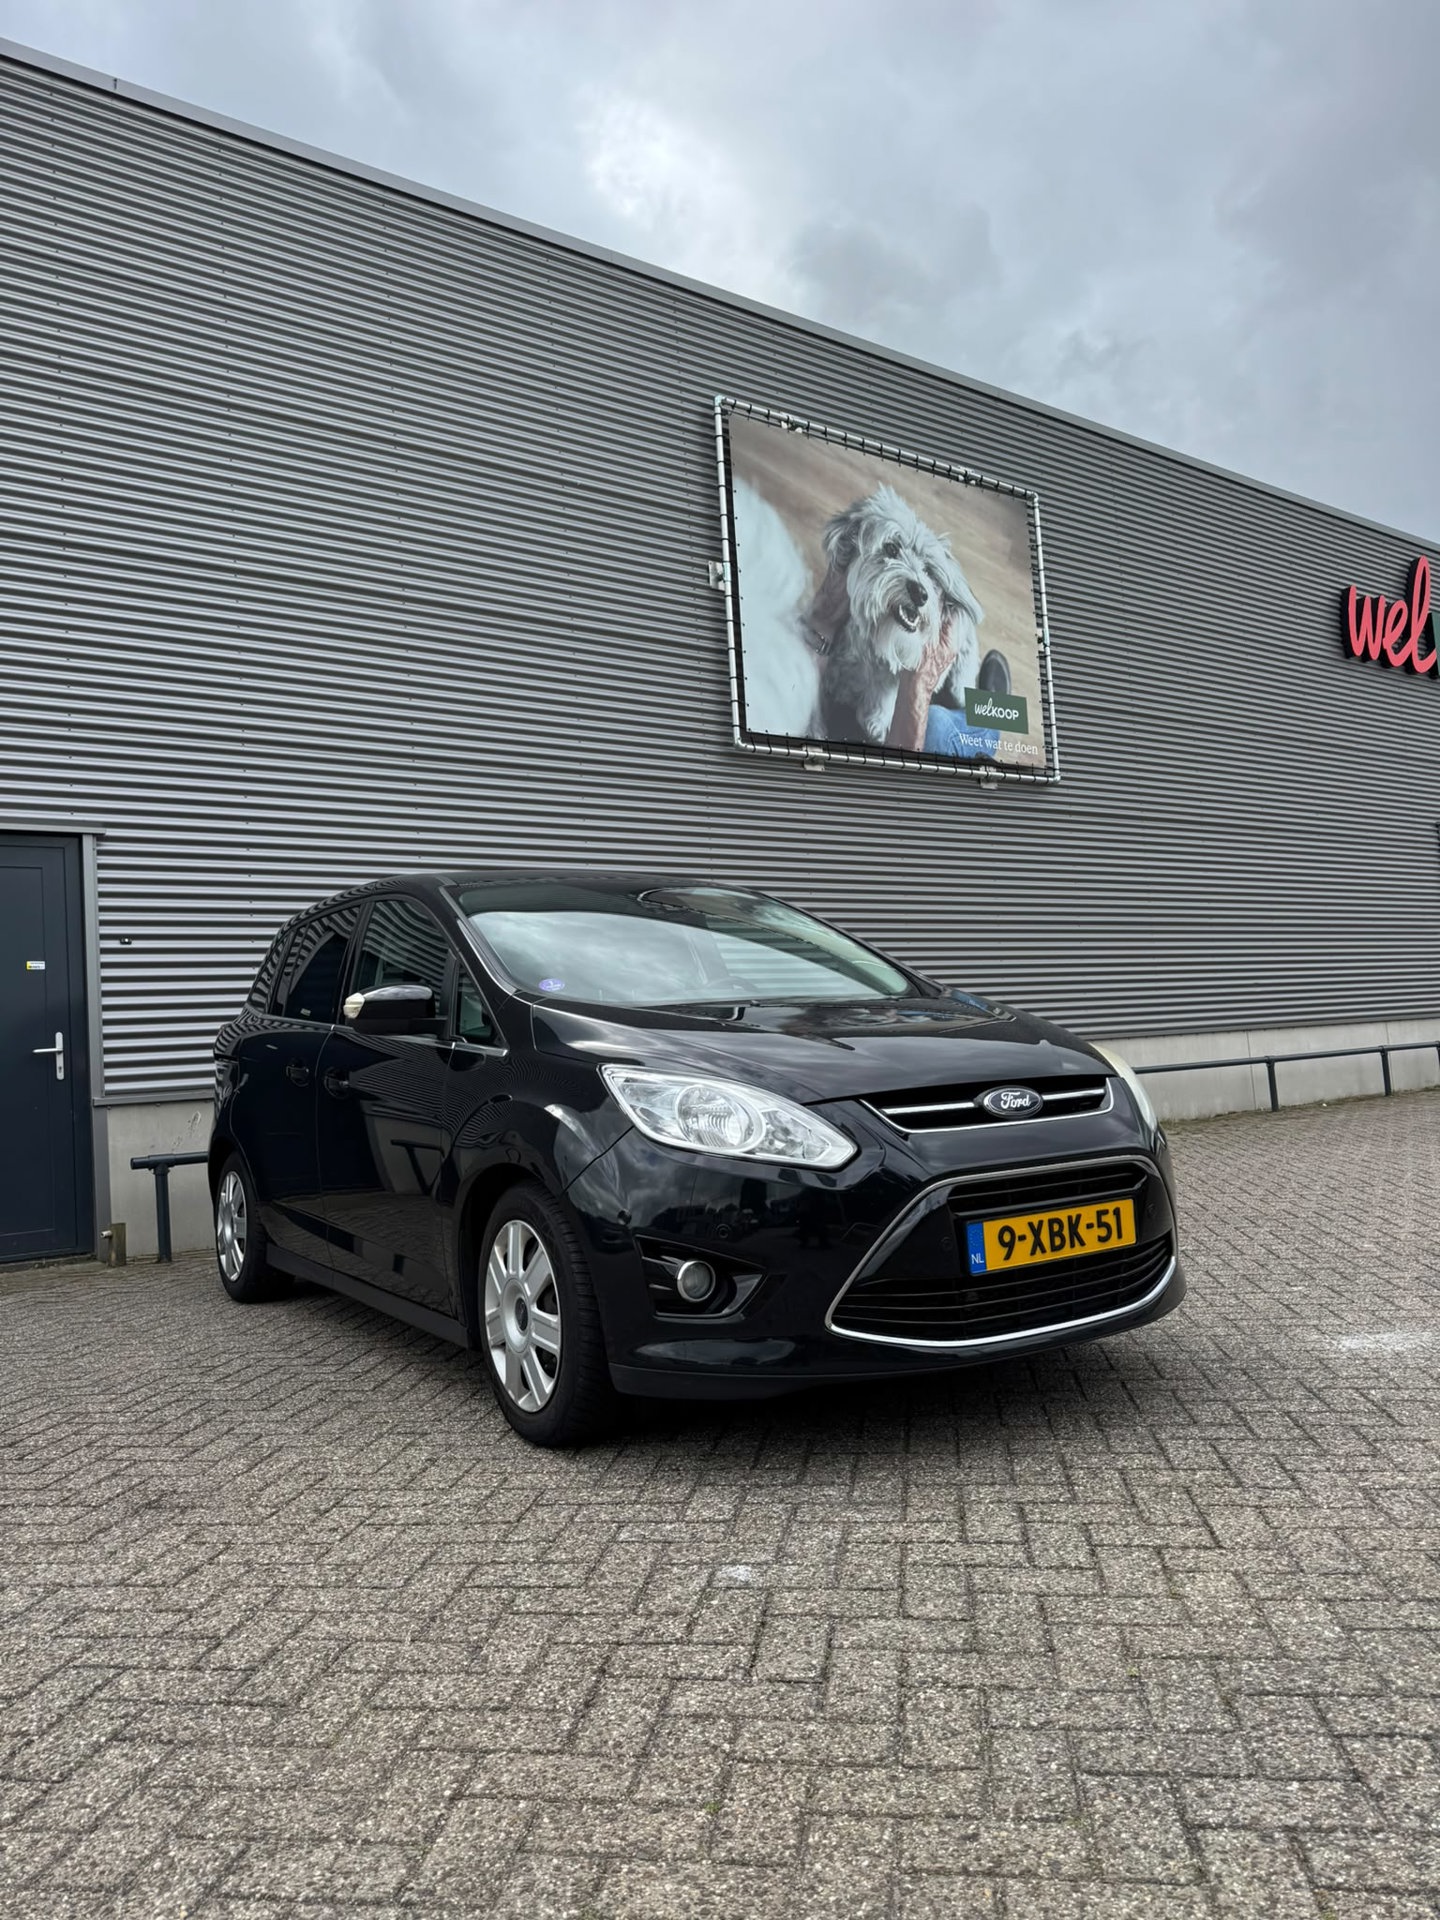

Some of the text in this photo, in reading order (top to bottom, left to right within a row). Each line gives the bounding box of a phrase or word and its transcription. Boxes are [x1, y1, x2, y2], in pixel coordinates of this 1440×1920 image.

[959, 733, 1038, 755] Weet wat te doen
[1000, 1090, 1032, 1110] Ford
[997, 1206, 1123, 1261] 9-XBK-51
[971, 1253, 985, 1265] NL
